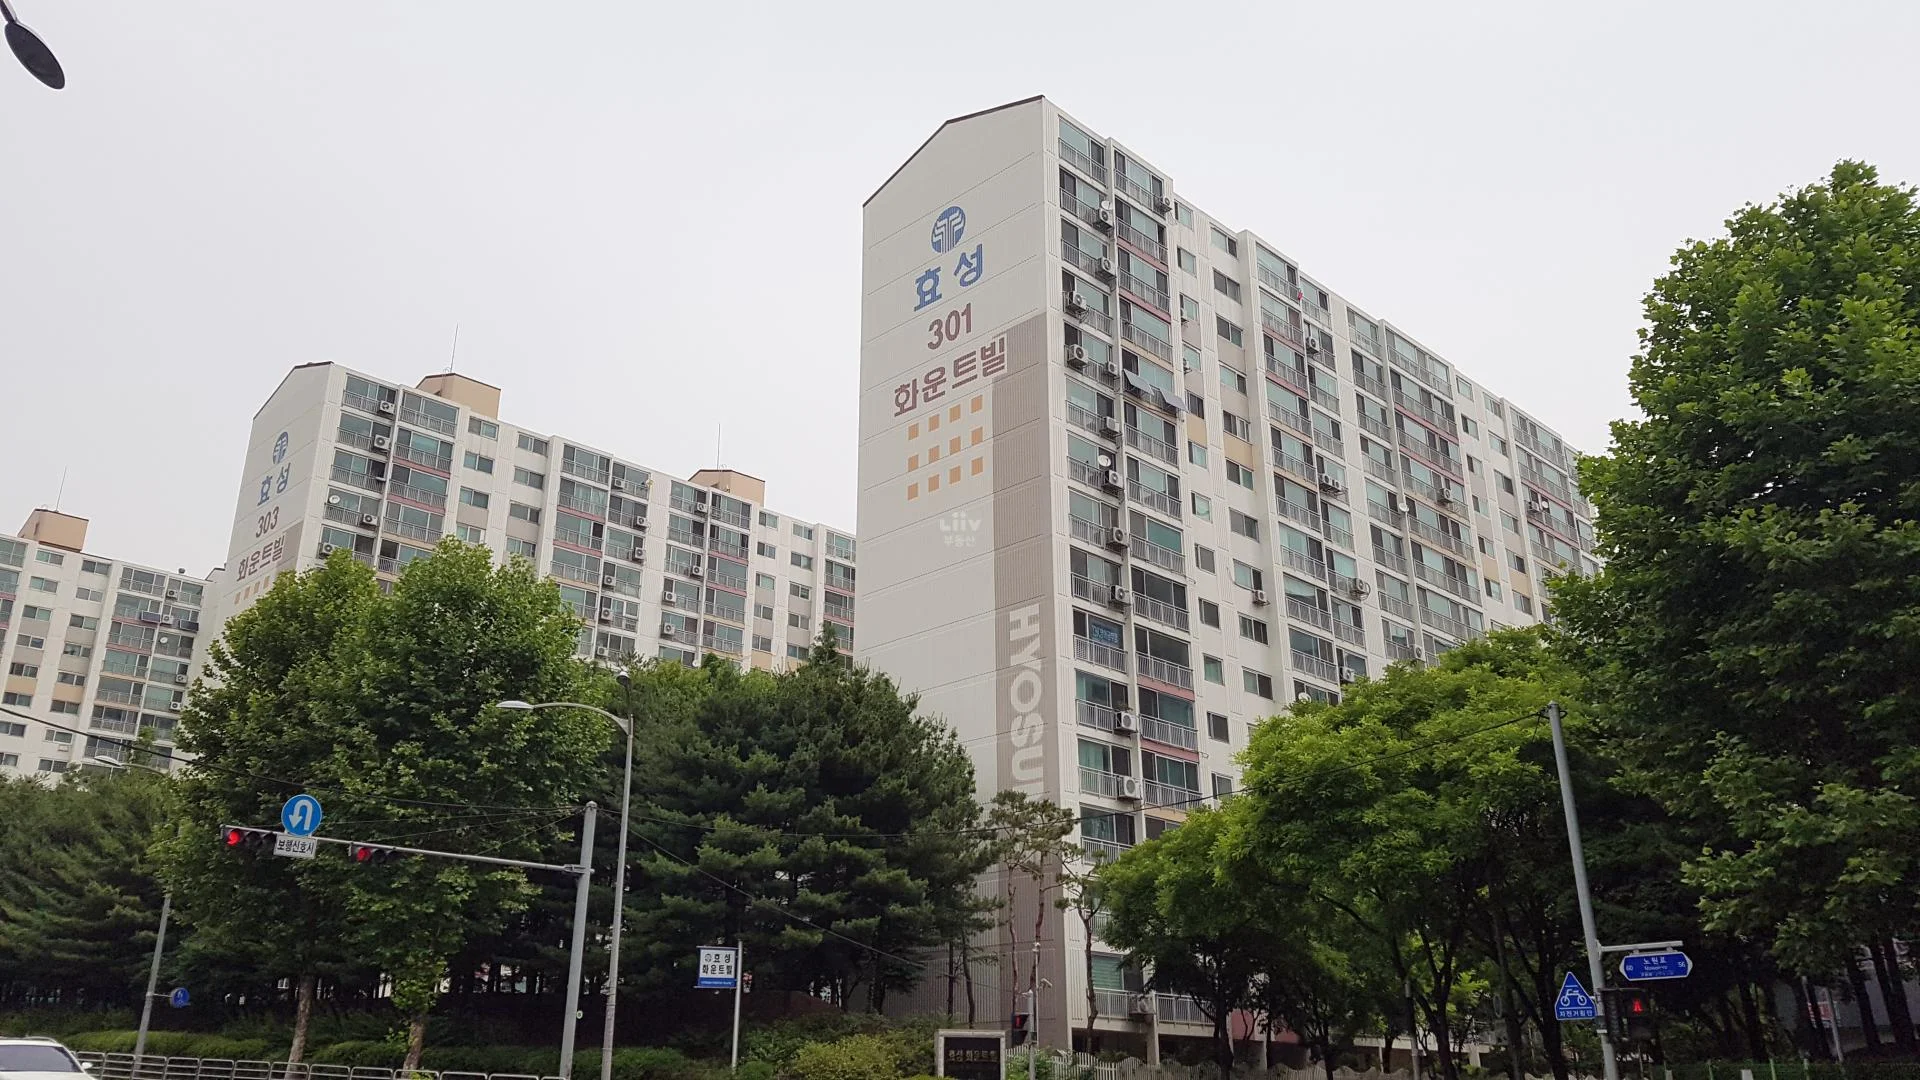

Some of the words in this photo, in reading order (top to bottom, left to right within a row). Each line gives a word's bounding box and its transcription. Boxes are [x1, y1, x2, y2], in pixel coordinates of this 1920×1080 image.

[913, 243, 983, 312] 효성
[927, 302, 972, 350] 301
[893, 337, 1005, 417] 화운트빌
[257, 462, 291, 507] 효성
[255, 506, 280, 538] 303
[236, 535, 286, 582] 화운트빌
[277, 839, 314, 855] 보행신호시
[713, 953, 731, 963] 효성
